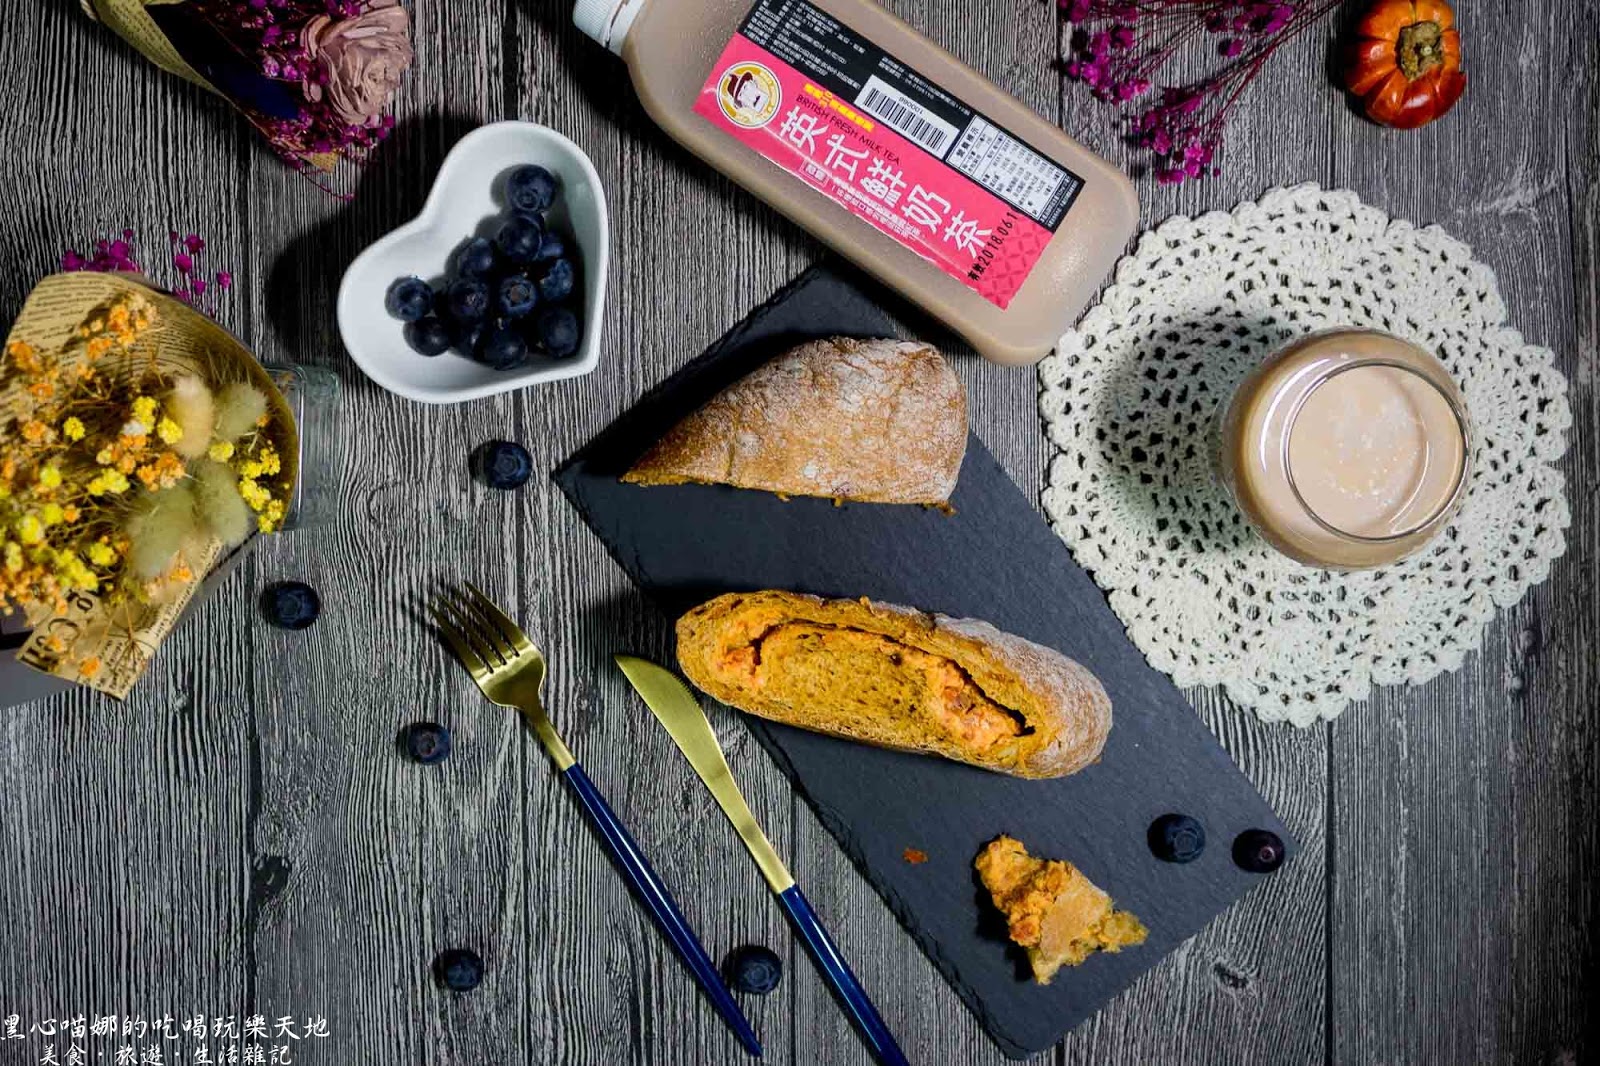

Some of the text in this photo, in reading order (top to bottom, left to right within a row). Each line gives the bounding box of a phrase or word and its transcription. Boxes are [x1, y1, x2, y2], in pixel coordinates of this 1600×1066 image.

[796, 94, 830, 121] BRITISH
[829, 115, 859, 140] FRESH
[858, 130, 883, 154] MILK
[882, 147, 901, 166] TEA
[779, 105, 993, 260] 英式鮮奶茶
[967, 208, 1021, 282] 有效2018.061
